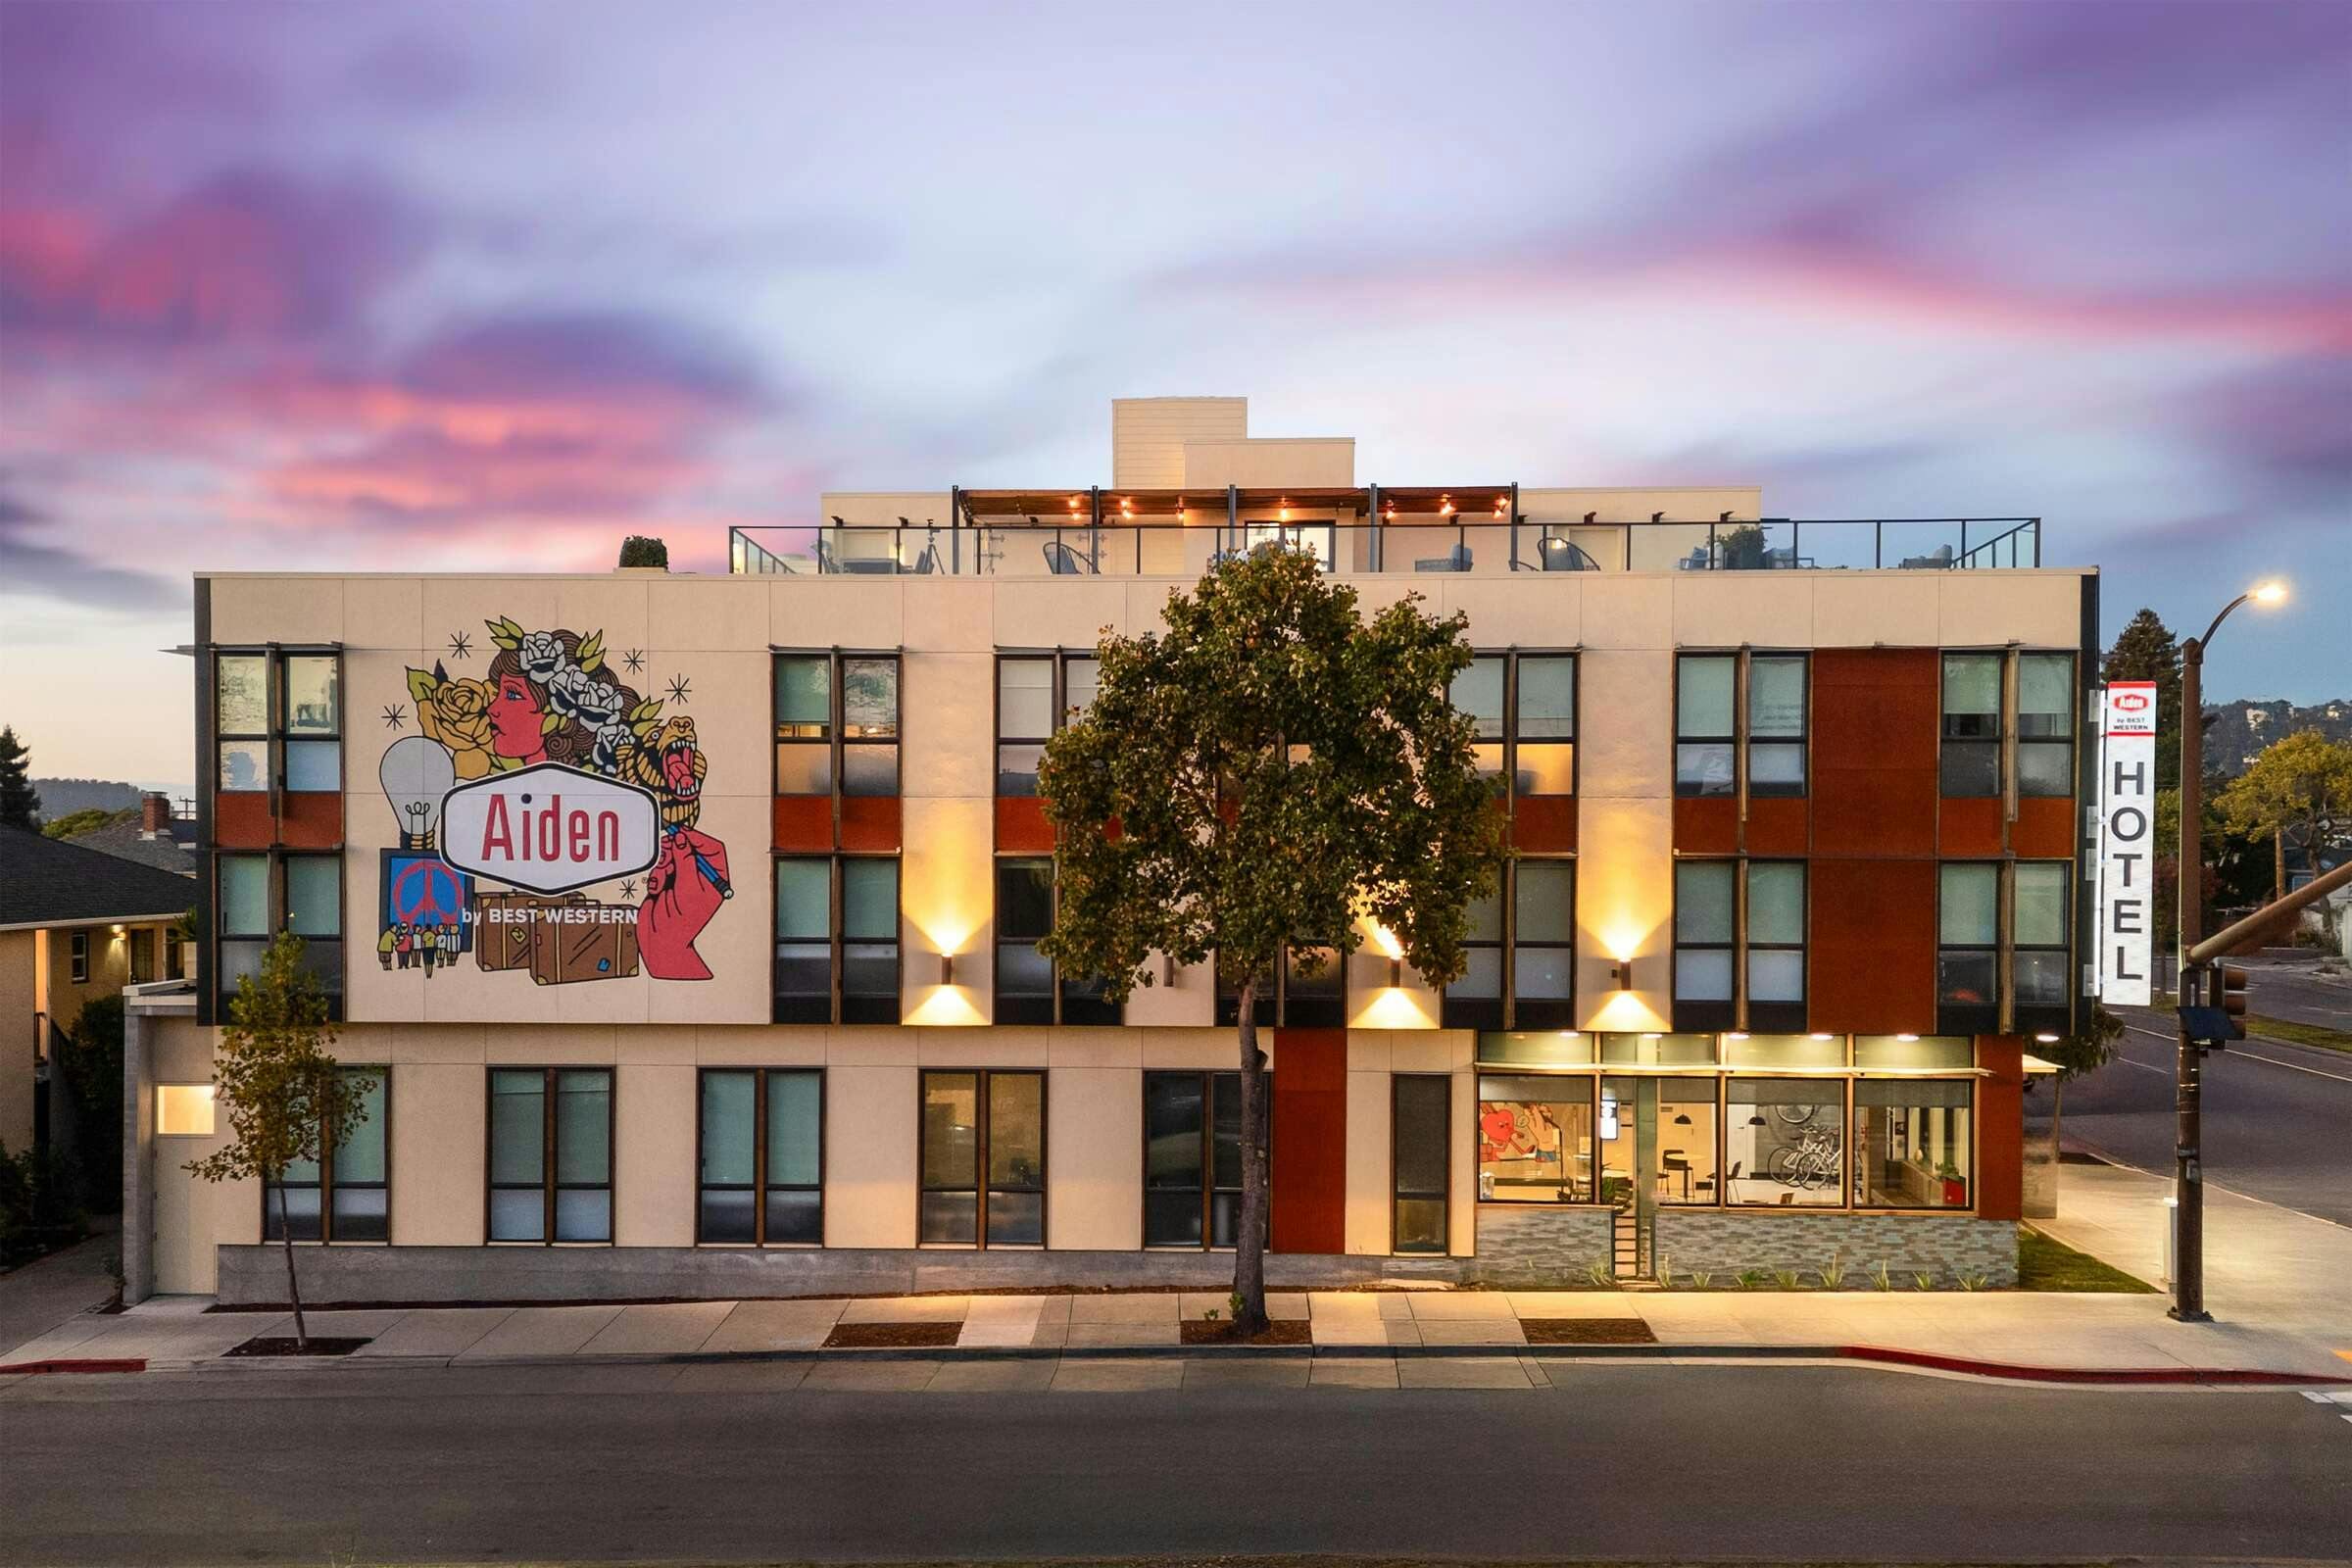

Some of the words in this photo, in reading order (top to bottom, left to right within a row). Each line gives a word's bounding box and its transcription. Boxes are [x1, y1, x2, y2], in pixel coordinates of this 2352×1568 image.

[481, 793, 619, 862] Aiden
[2111, 761, 2147, 980] HOTEL
[462, 907, 482, 925] by
[489, 908, 538, 924] BEST
[545, 908, 637, 924] WESTERN
